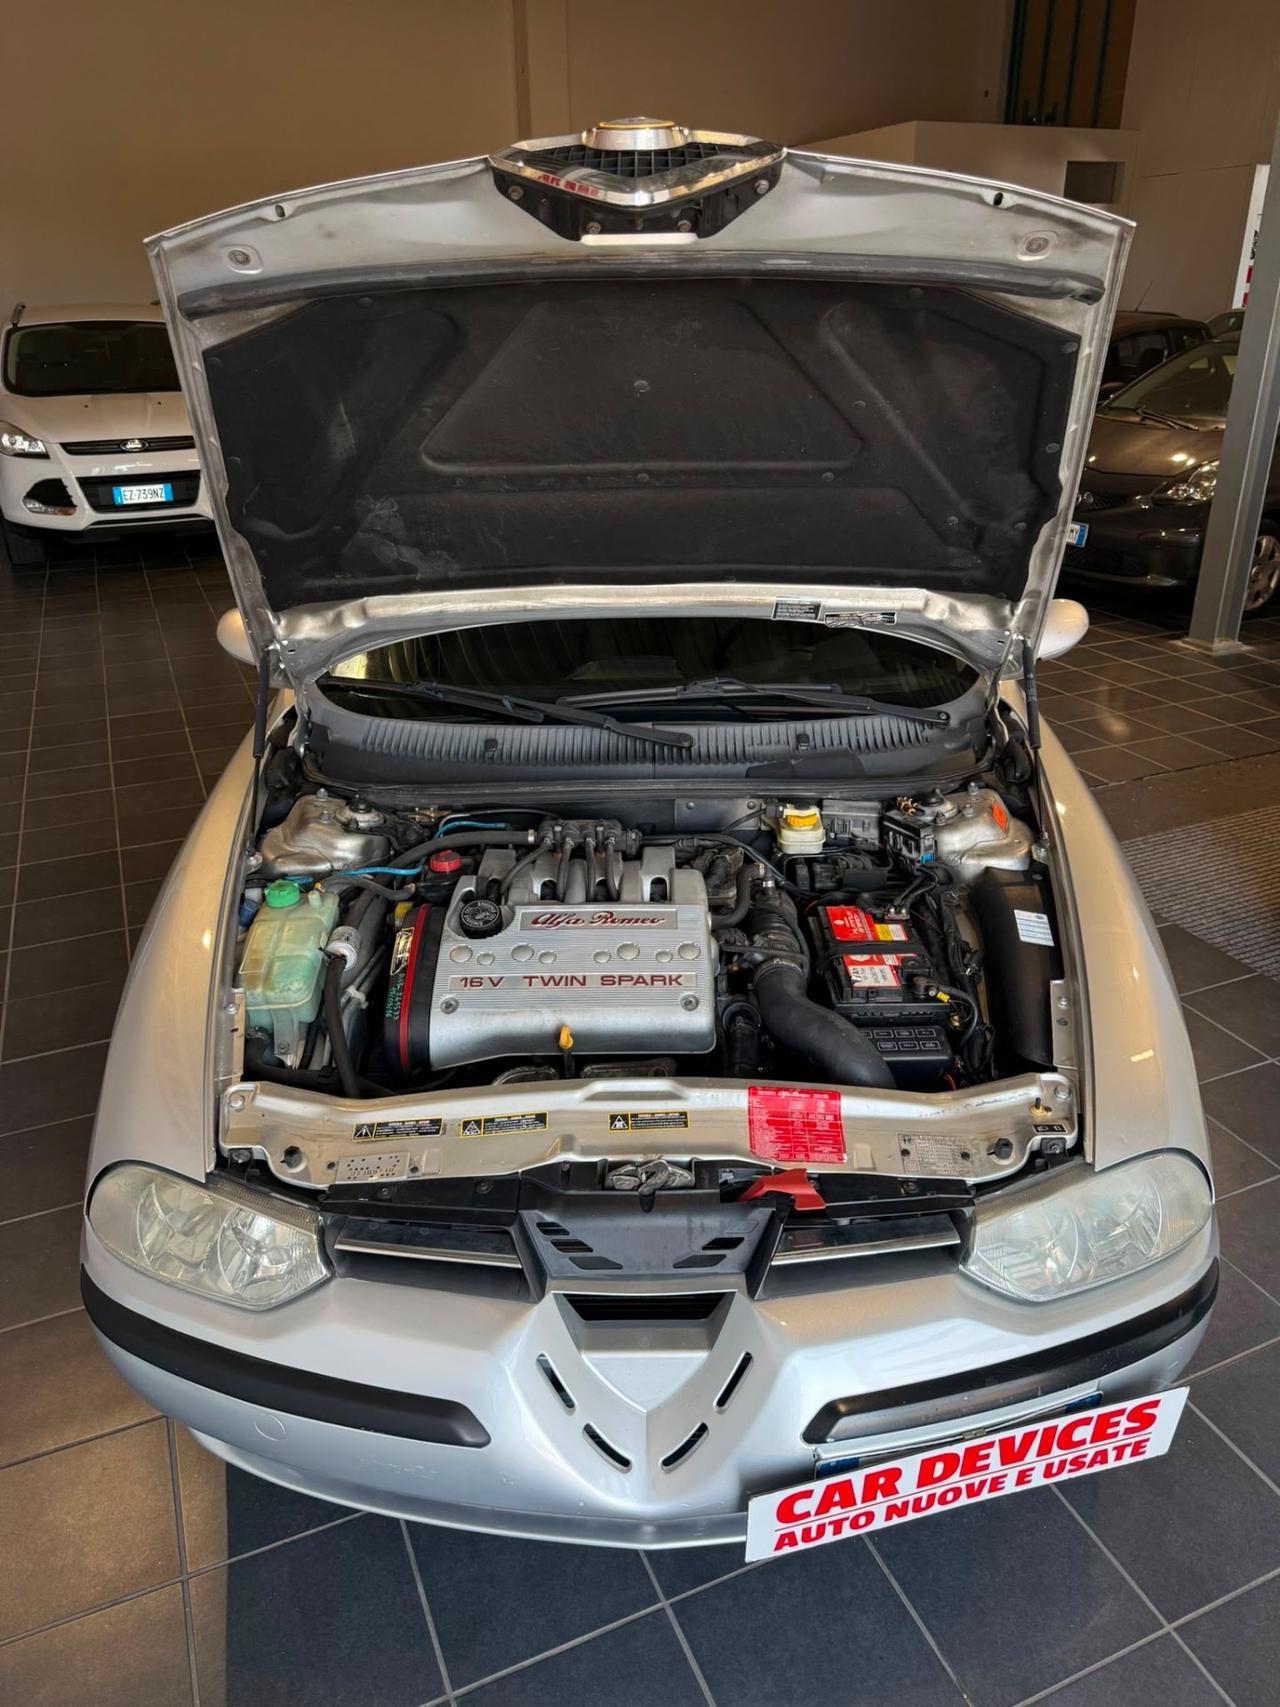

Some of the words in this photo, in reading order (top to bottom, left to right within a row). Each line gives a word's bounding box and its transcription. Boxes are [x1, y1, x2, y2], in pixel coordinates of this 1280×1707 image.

[531, 912, 586, 928] Alfa
[589, 911, 666, 926] Romeo
[523, 975, 587, 987] TWIN
[600, 974, 683, 987] SPARK
[776, 1466, 903, 1524] CAR
[916, 1399, 1160, 1489] DEVICES
[774, 1510, 876, 1552] AUTO
[885, 1474, 1007, 1522] NUOVE
[1015, 1467, 1034, 1485] E
[1042, 1438, 1148, 1480] USATE
